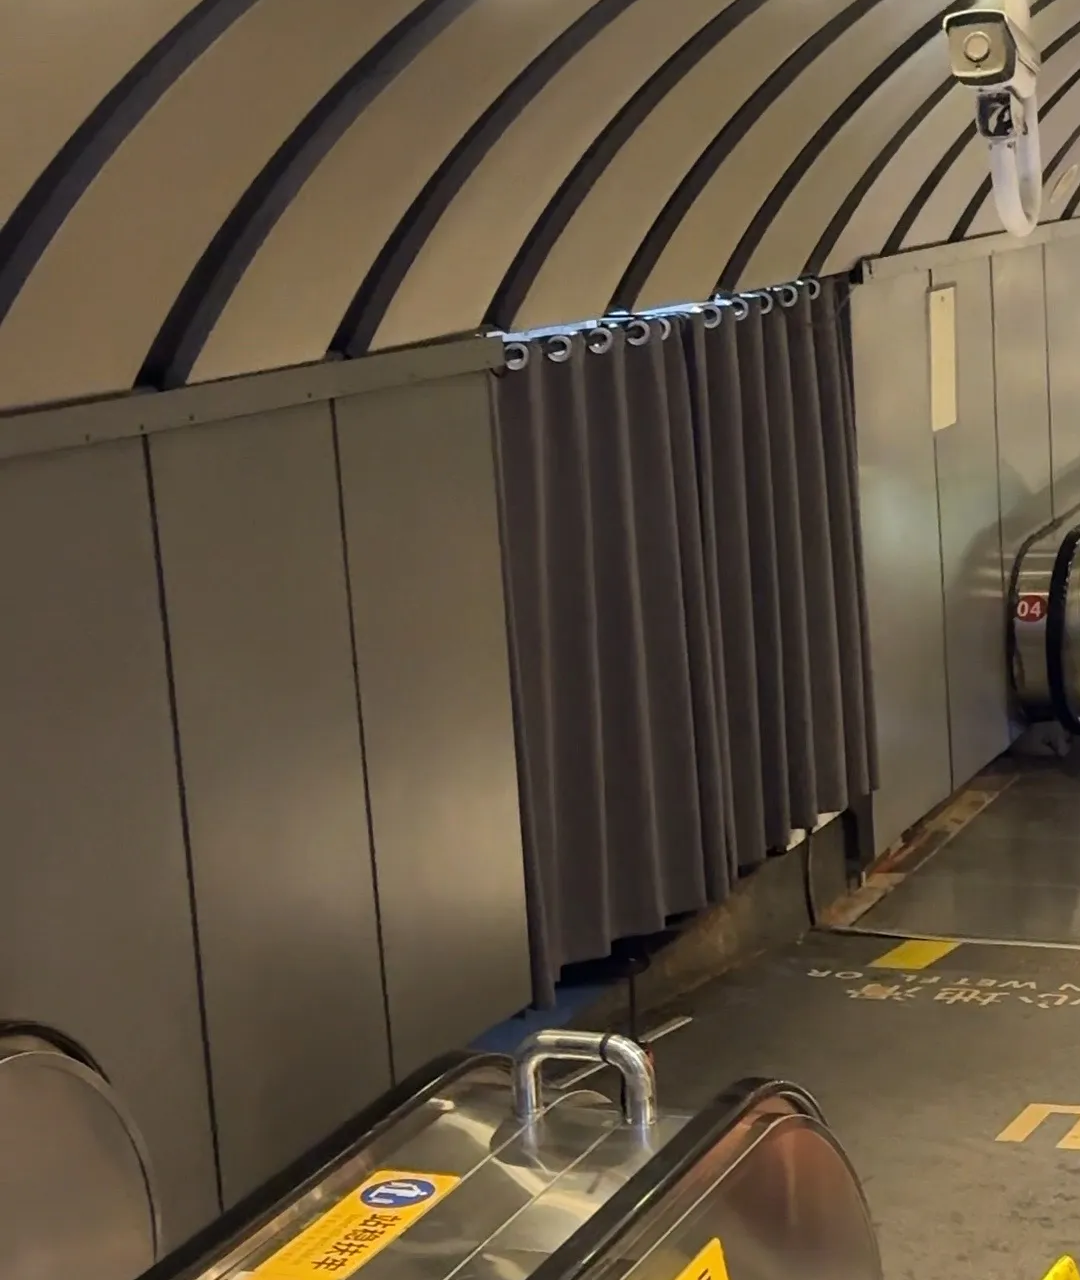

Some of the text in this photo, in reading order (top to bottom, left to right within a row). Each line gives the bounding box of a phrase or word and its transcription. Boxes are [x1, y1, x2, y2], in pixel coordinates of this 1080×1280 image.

[1016, 600, 1042, 618] 04
[311, 1213, 402, 1271] 站稳扶牢
